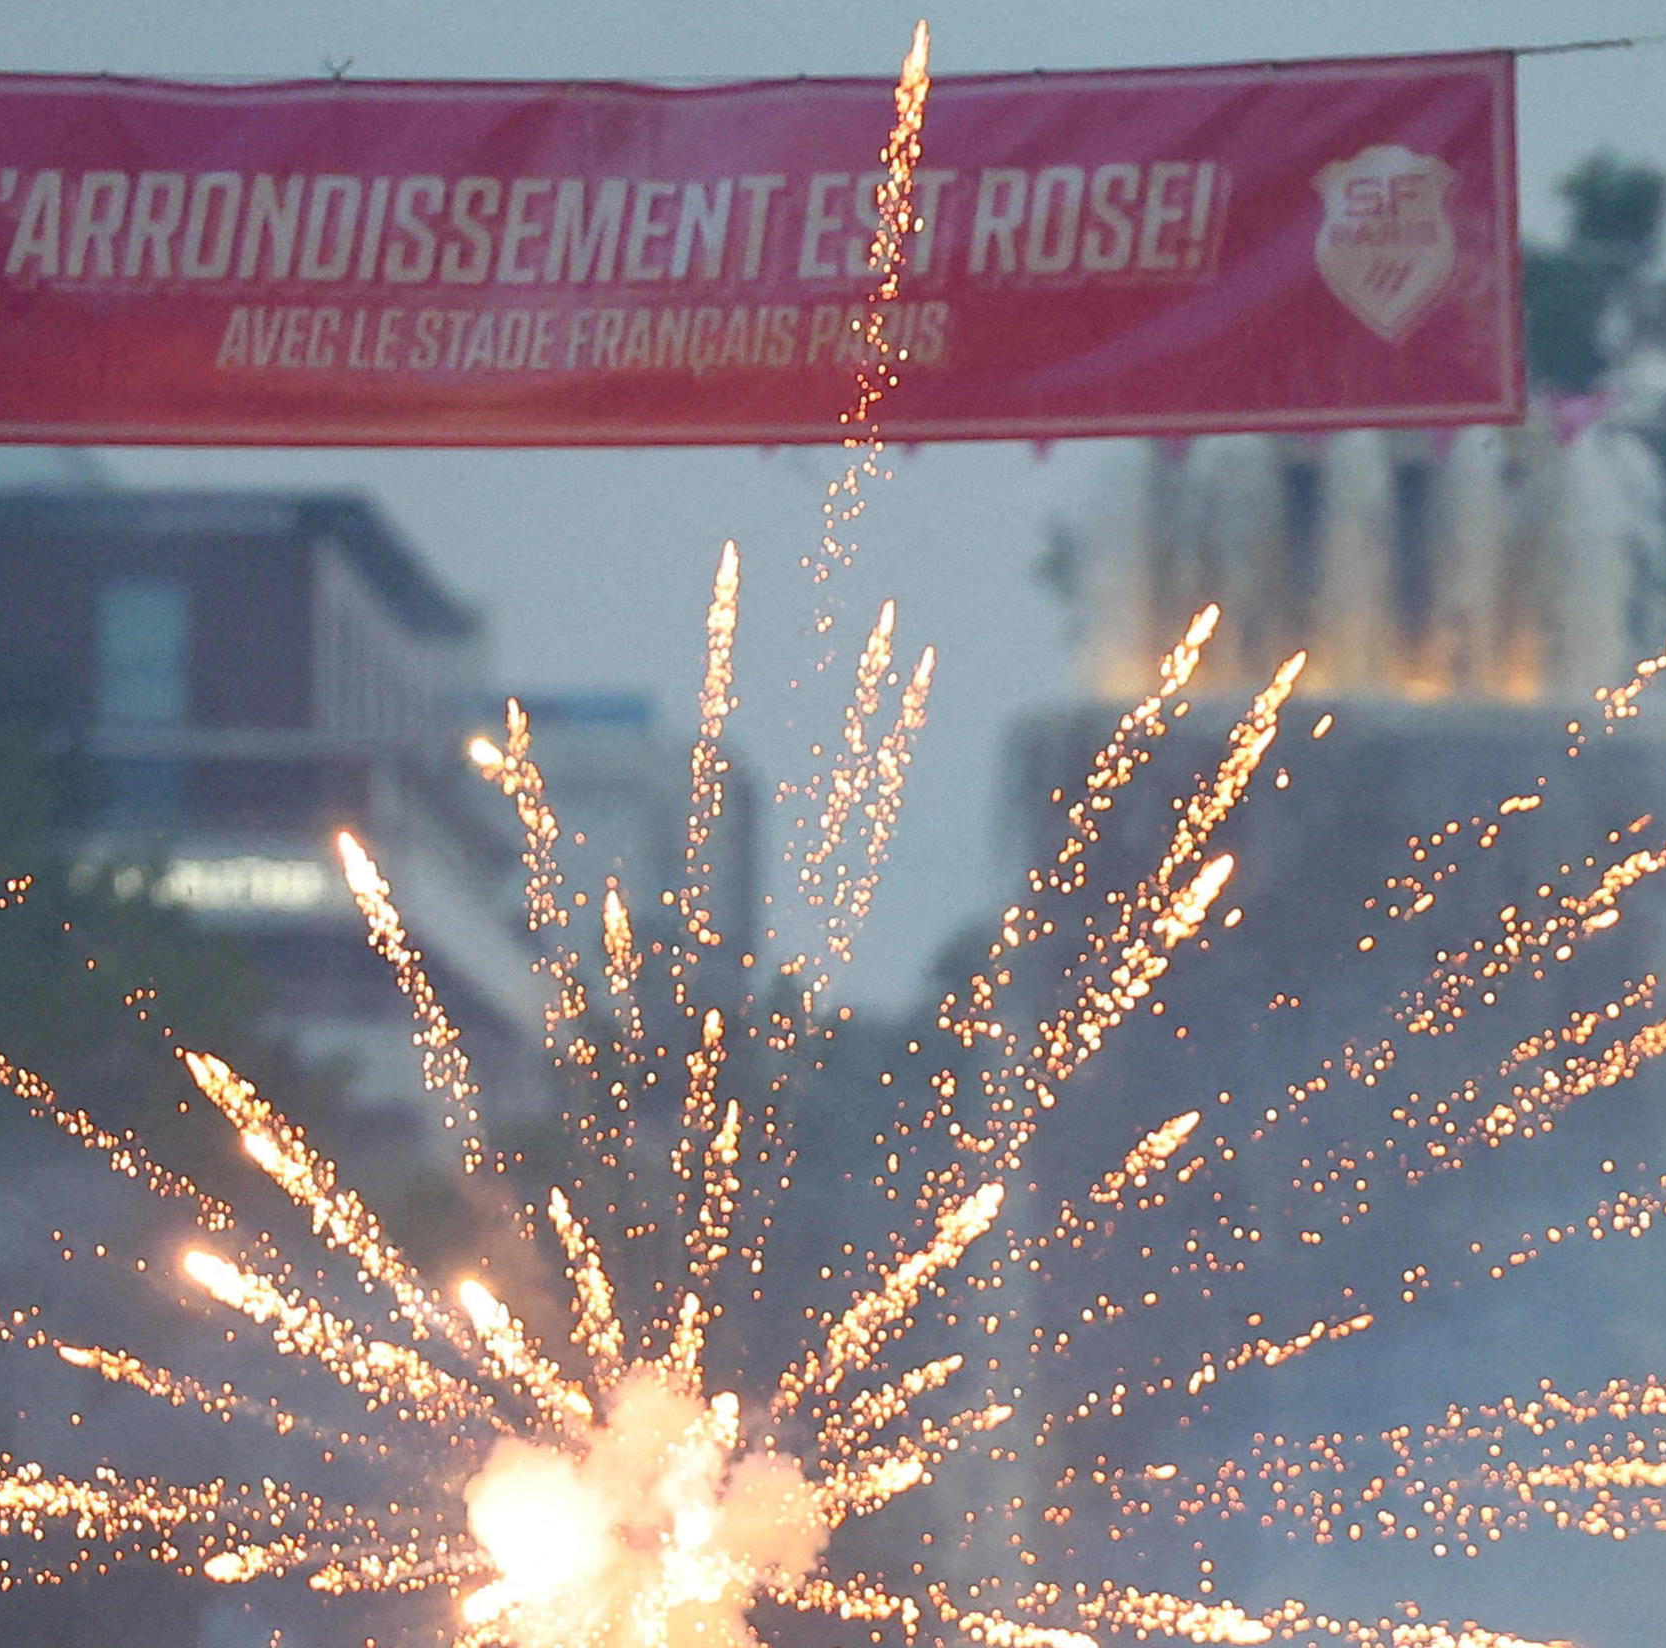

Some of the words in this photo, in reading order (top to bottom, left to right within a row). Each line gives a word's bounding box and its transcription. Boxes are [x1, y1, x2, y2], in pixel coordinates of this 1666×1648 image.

[798, 168, 959, 280] EST
[967, 160, 1218, 275] ROSE!
[1345, 172, 1429, 217] SF
[215, 305, 342, 370] AVEC
[347, 307, 405, 370] LE
[409, 306, 560, 371] STADE
[565, 303, 800, 376] FRANÇAIS
[805, 300, 950, 368] PARIS
